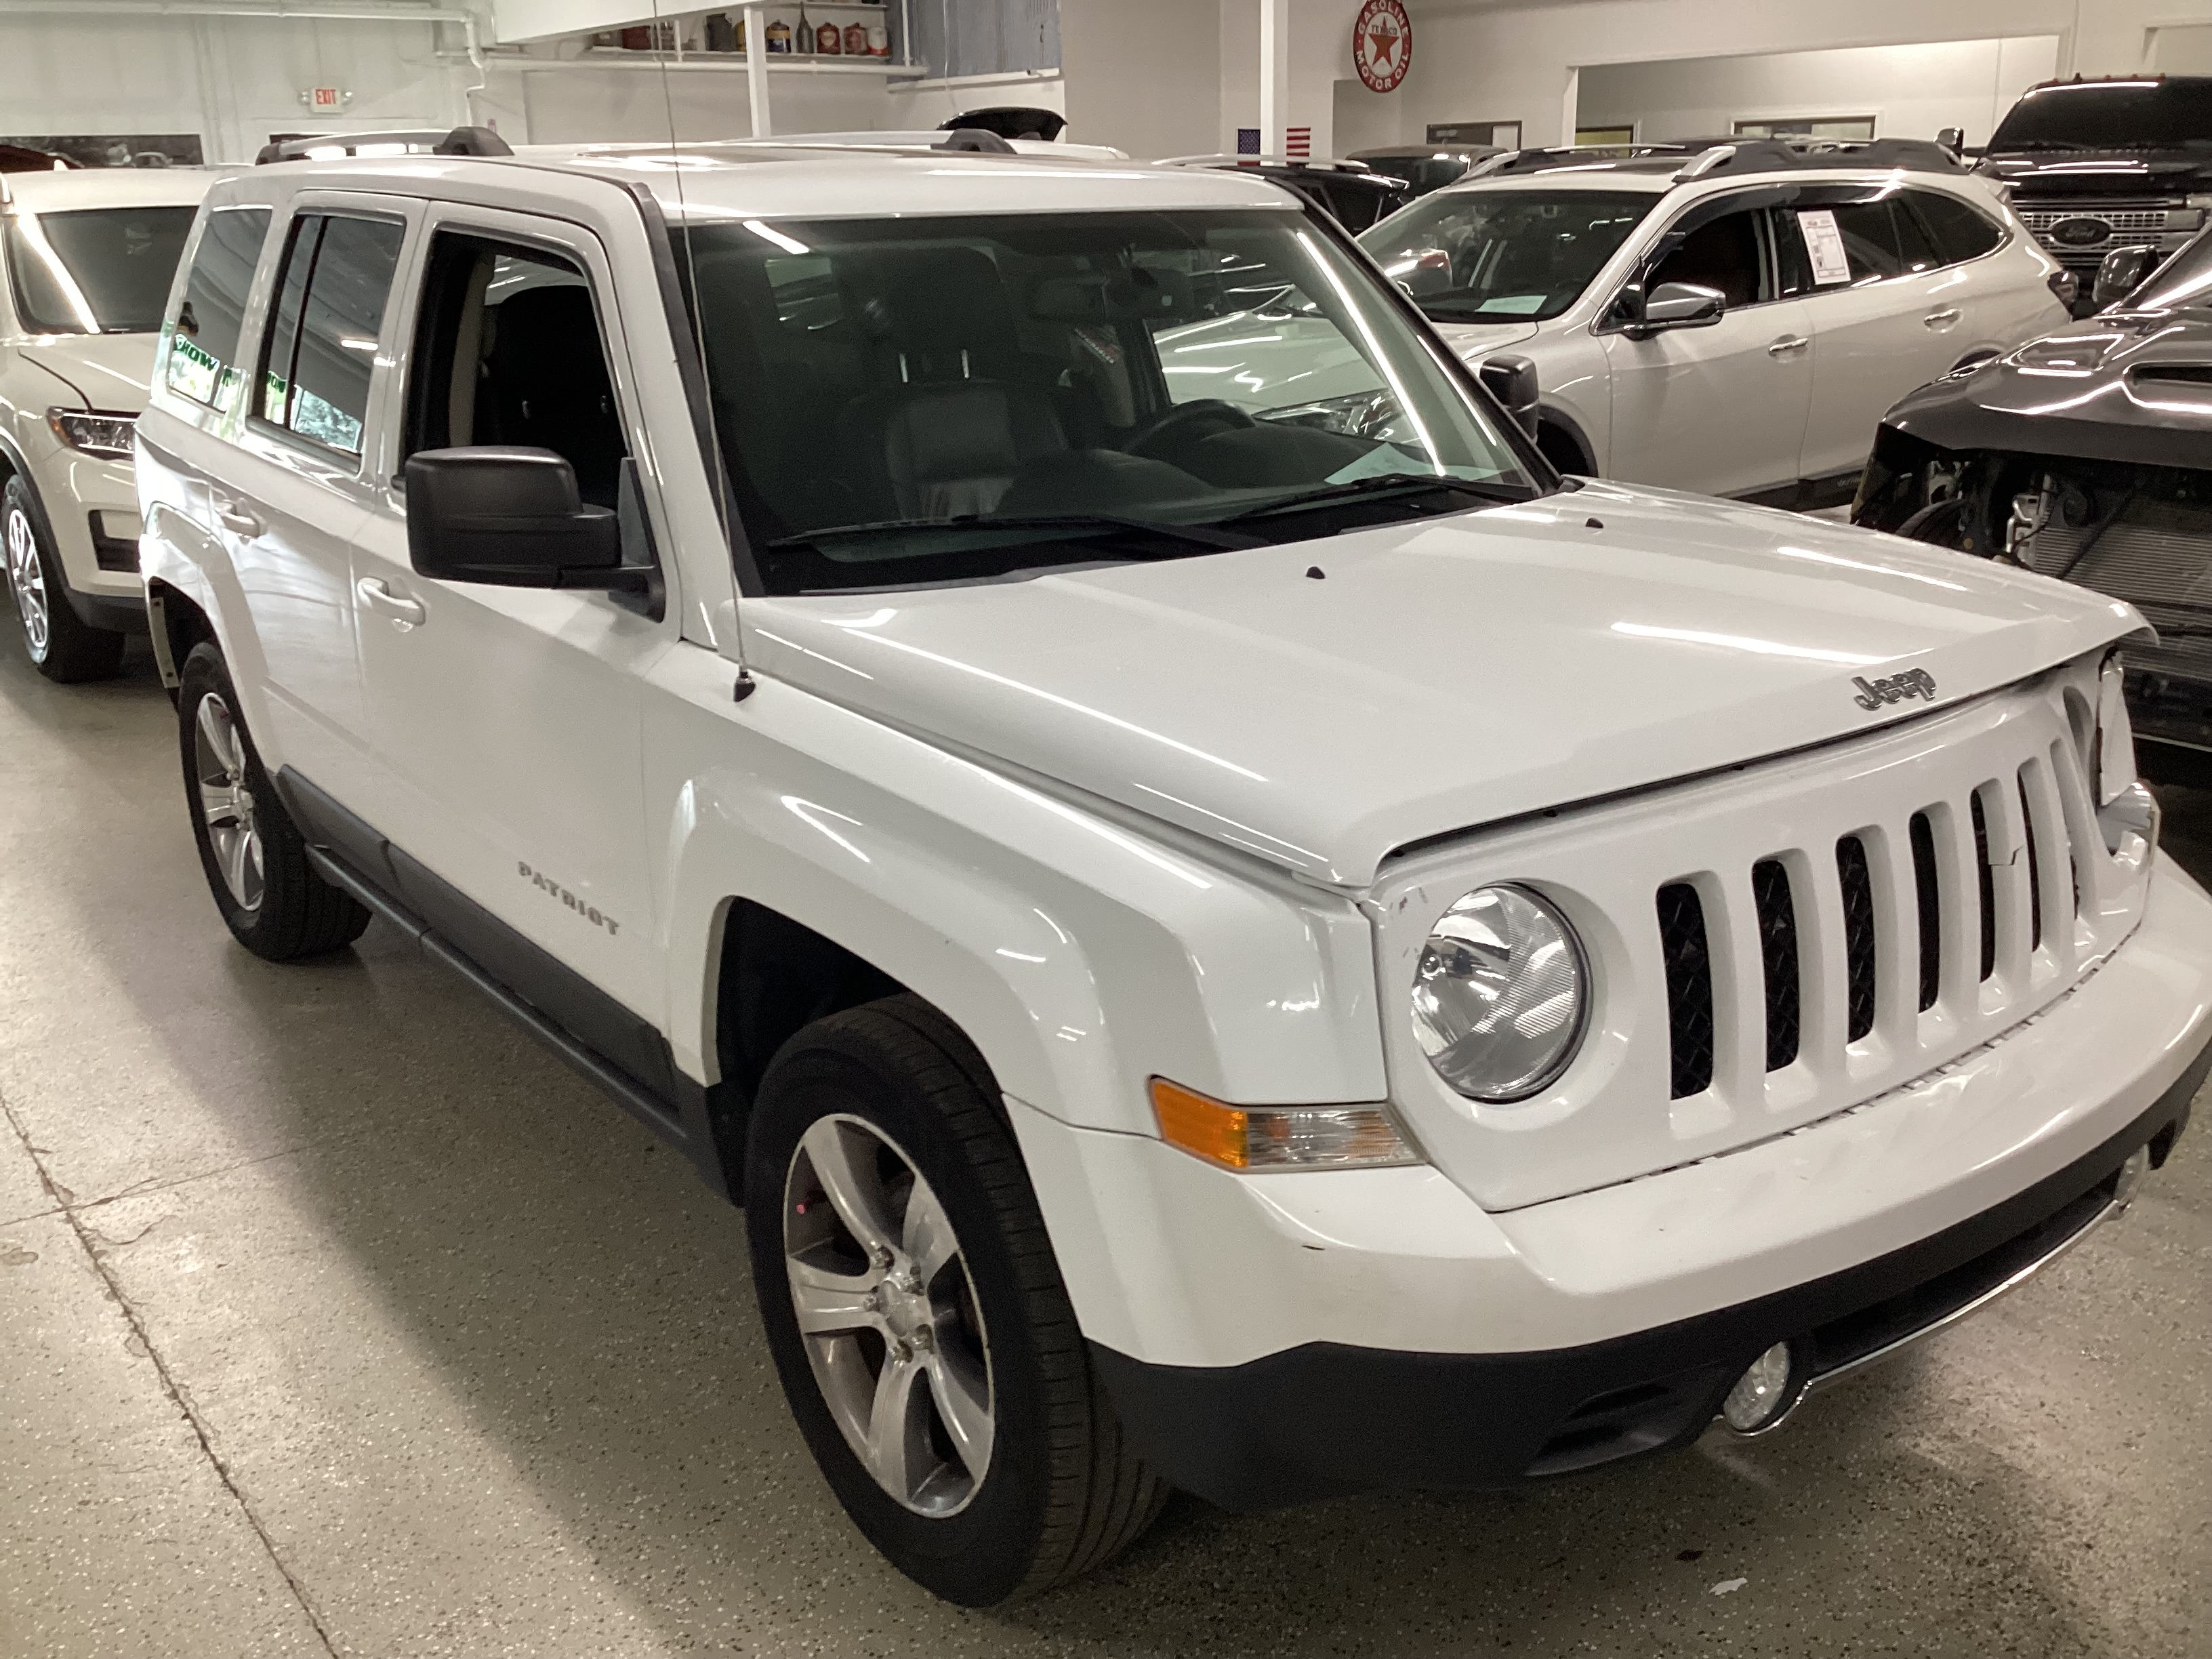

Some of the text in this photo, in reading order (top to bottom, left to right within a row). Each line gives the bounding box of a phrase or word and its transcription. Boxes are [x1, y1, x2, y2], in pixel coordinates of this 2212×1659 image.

[1358, 0, 1409, 37] GASOLINE
[1356, 50, 1408, 90] MOTOR OIL
[316, 89, 336, 104] EXIT
[1851, 668, 1936, 711] Jeep
[518, 861, 619, 935] PATRIOT
